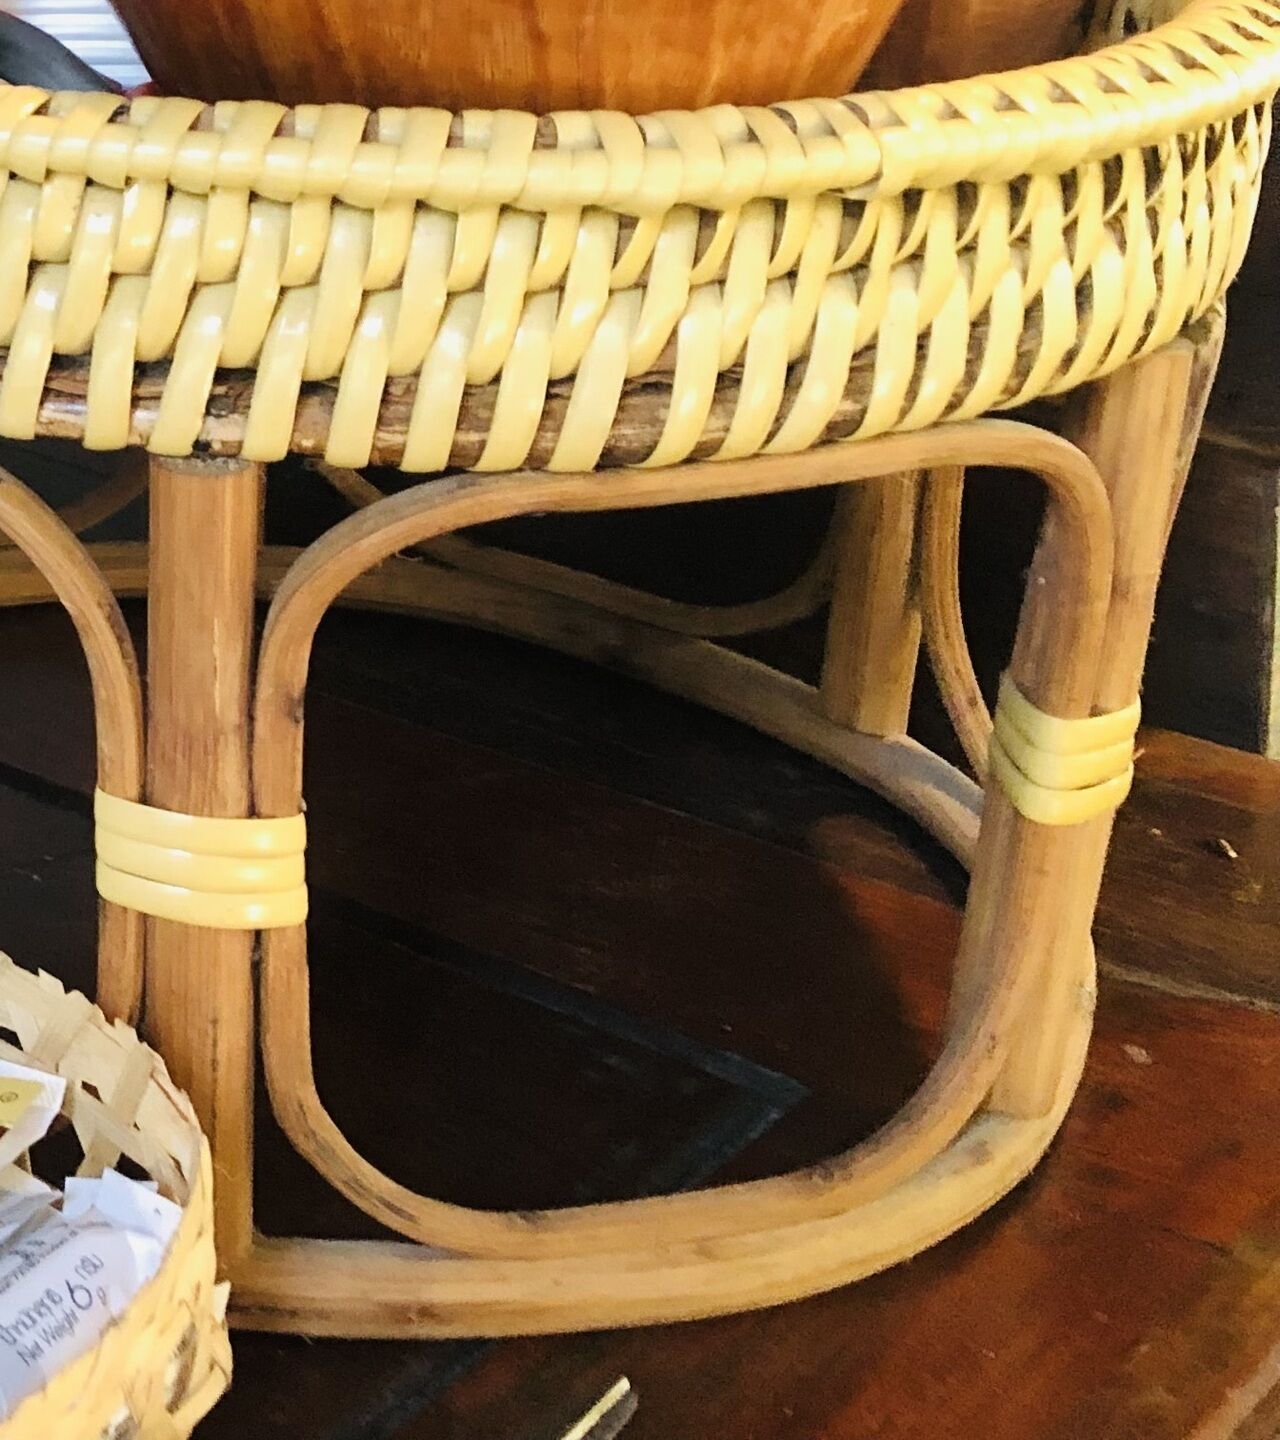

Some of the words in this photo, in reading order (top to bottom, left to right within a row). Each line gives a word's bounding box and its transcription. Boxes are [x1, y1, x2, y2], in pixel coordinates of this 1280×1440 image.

[58, 1271, 98, 1313] 6
[13, 1335, 46, 1368] Net
[37, 1305, 81, 1348] Weight
